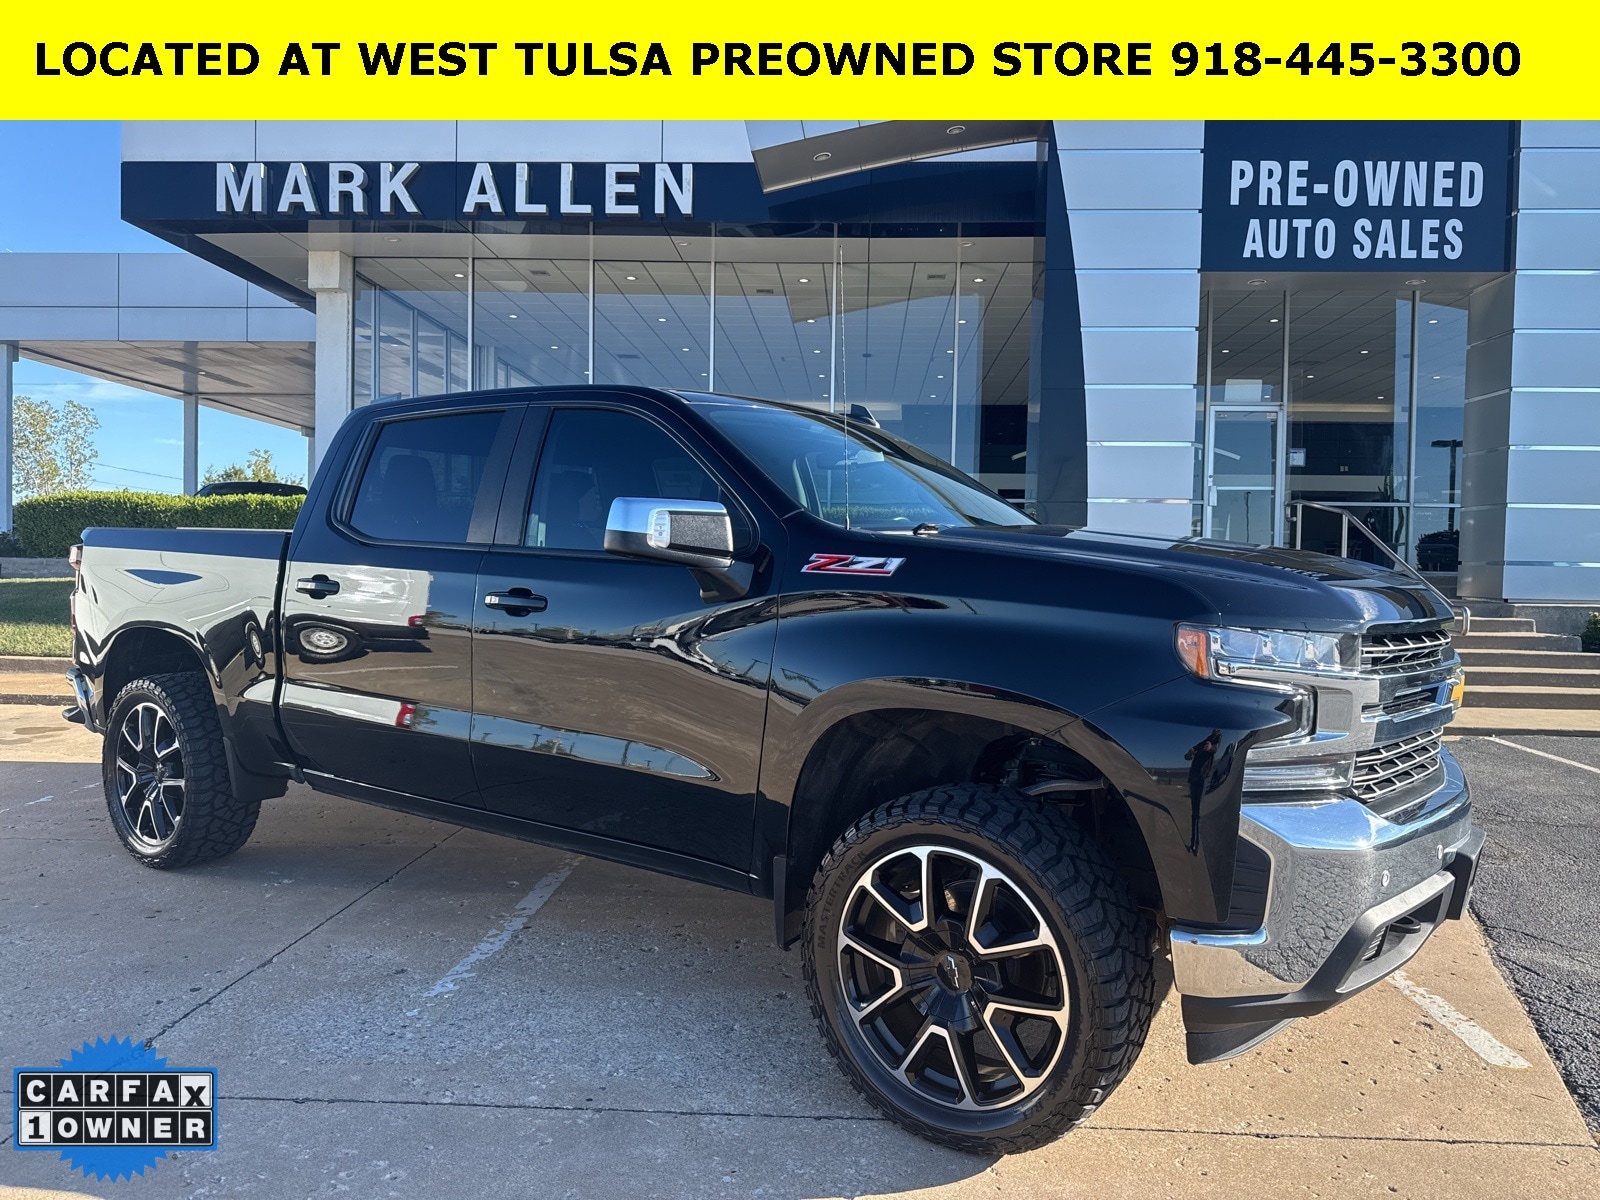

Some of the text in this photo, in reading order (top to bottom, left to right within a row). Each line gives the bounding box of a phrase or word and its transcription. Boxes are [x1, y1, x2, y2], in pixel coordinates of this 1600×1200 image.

[215, 162, 694, 216] MARK ALLEN
[1229, 159, 1484, 207] PRE-OWNED
[1242, 218, 1464, 260] AUTO SALES
[800, 553, 906, 576] Z71
